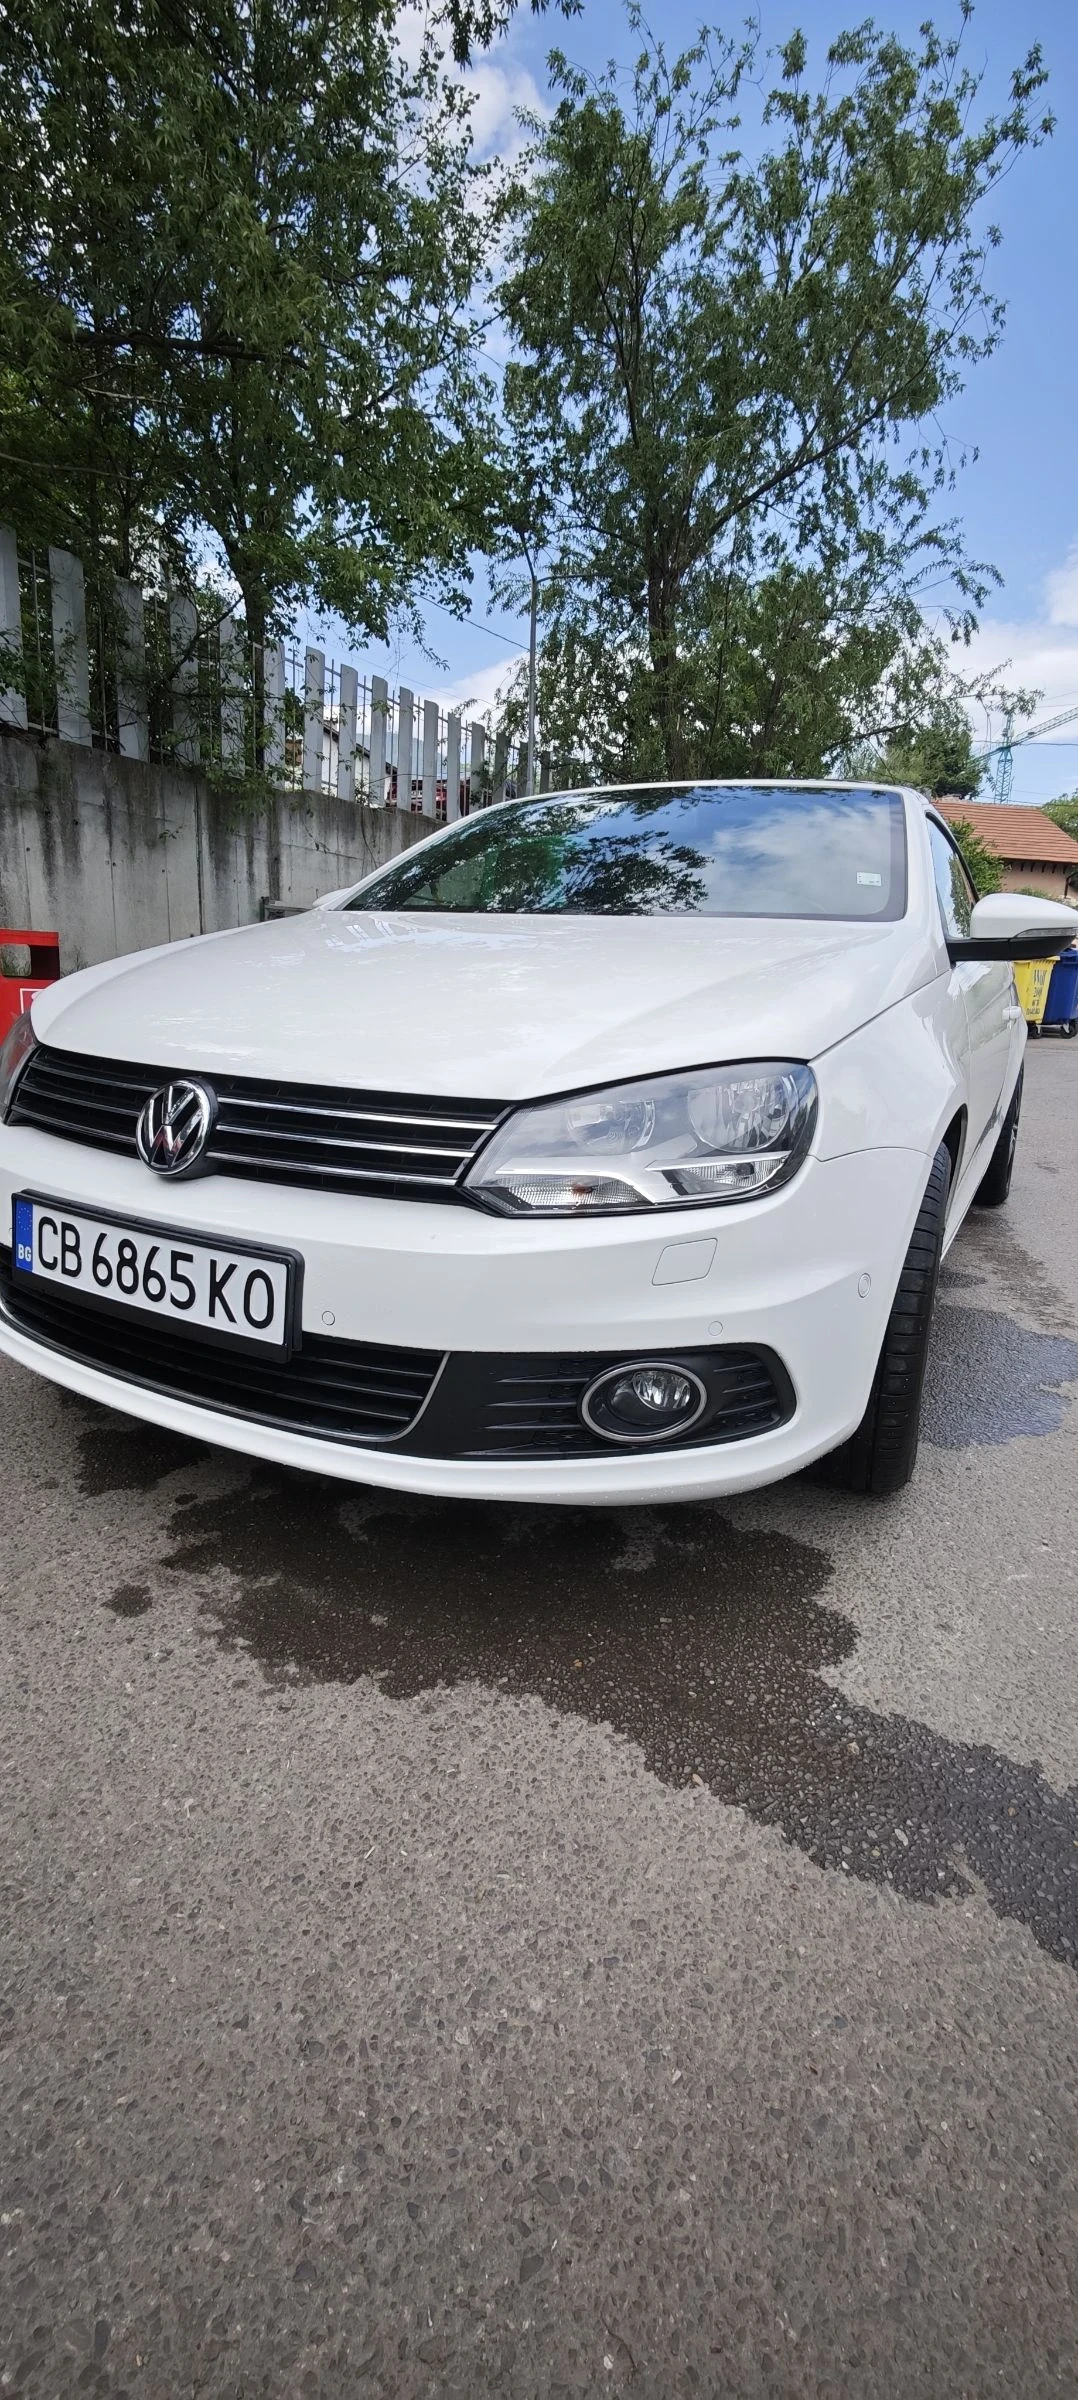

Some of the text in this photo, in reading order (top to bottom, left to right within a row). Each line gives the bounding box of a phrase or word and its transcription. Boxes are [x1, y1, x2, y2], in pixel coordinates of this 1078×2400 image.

[17, 1243, 32, 1262] BG
[38, 1216, 275, 1330] CB 6865 KO
